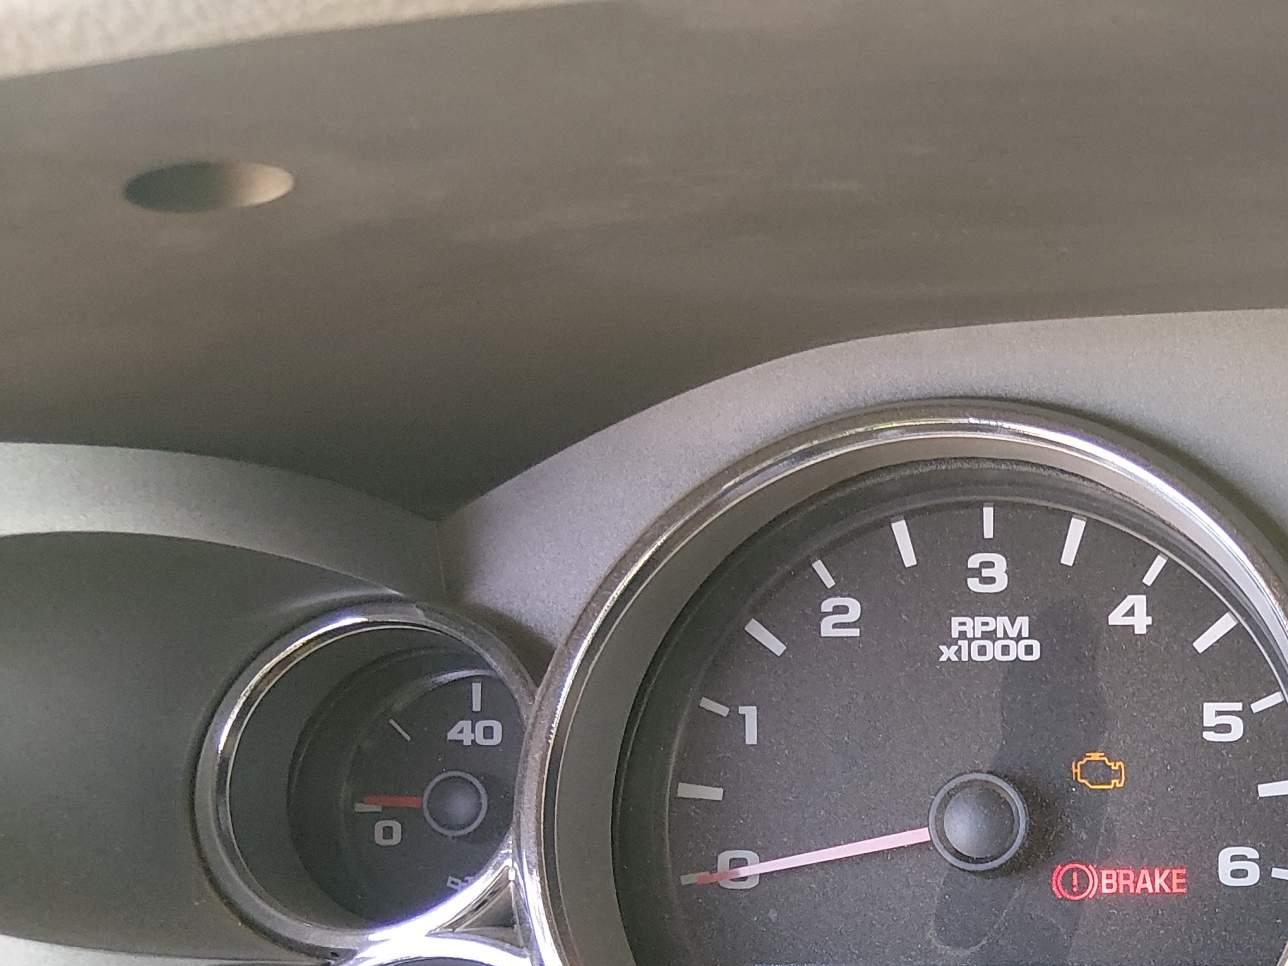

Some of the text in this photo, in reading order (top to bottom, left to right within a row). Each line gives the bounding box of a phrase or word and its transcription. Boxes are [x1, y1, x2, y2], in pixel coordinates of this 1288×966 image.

[967, 553, 1009, 593] 3
[820, 596, 861, 637] 2
[951, 617, 1030, 638] RPM
[1107, 594, 1152, 634] 4
[939, 639, 1041, 661] x1000
[447, 719, 502, 746] 40
[738, 706, 757, 744] 1
[1203, 702, 1243, 741] 5
[374, 820, 402, 846] 0
[716, 850, 760, 889] 0
[1100, 869, 1187, 894] BRAKE
[1218, 847, 1260, 886] 6
